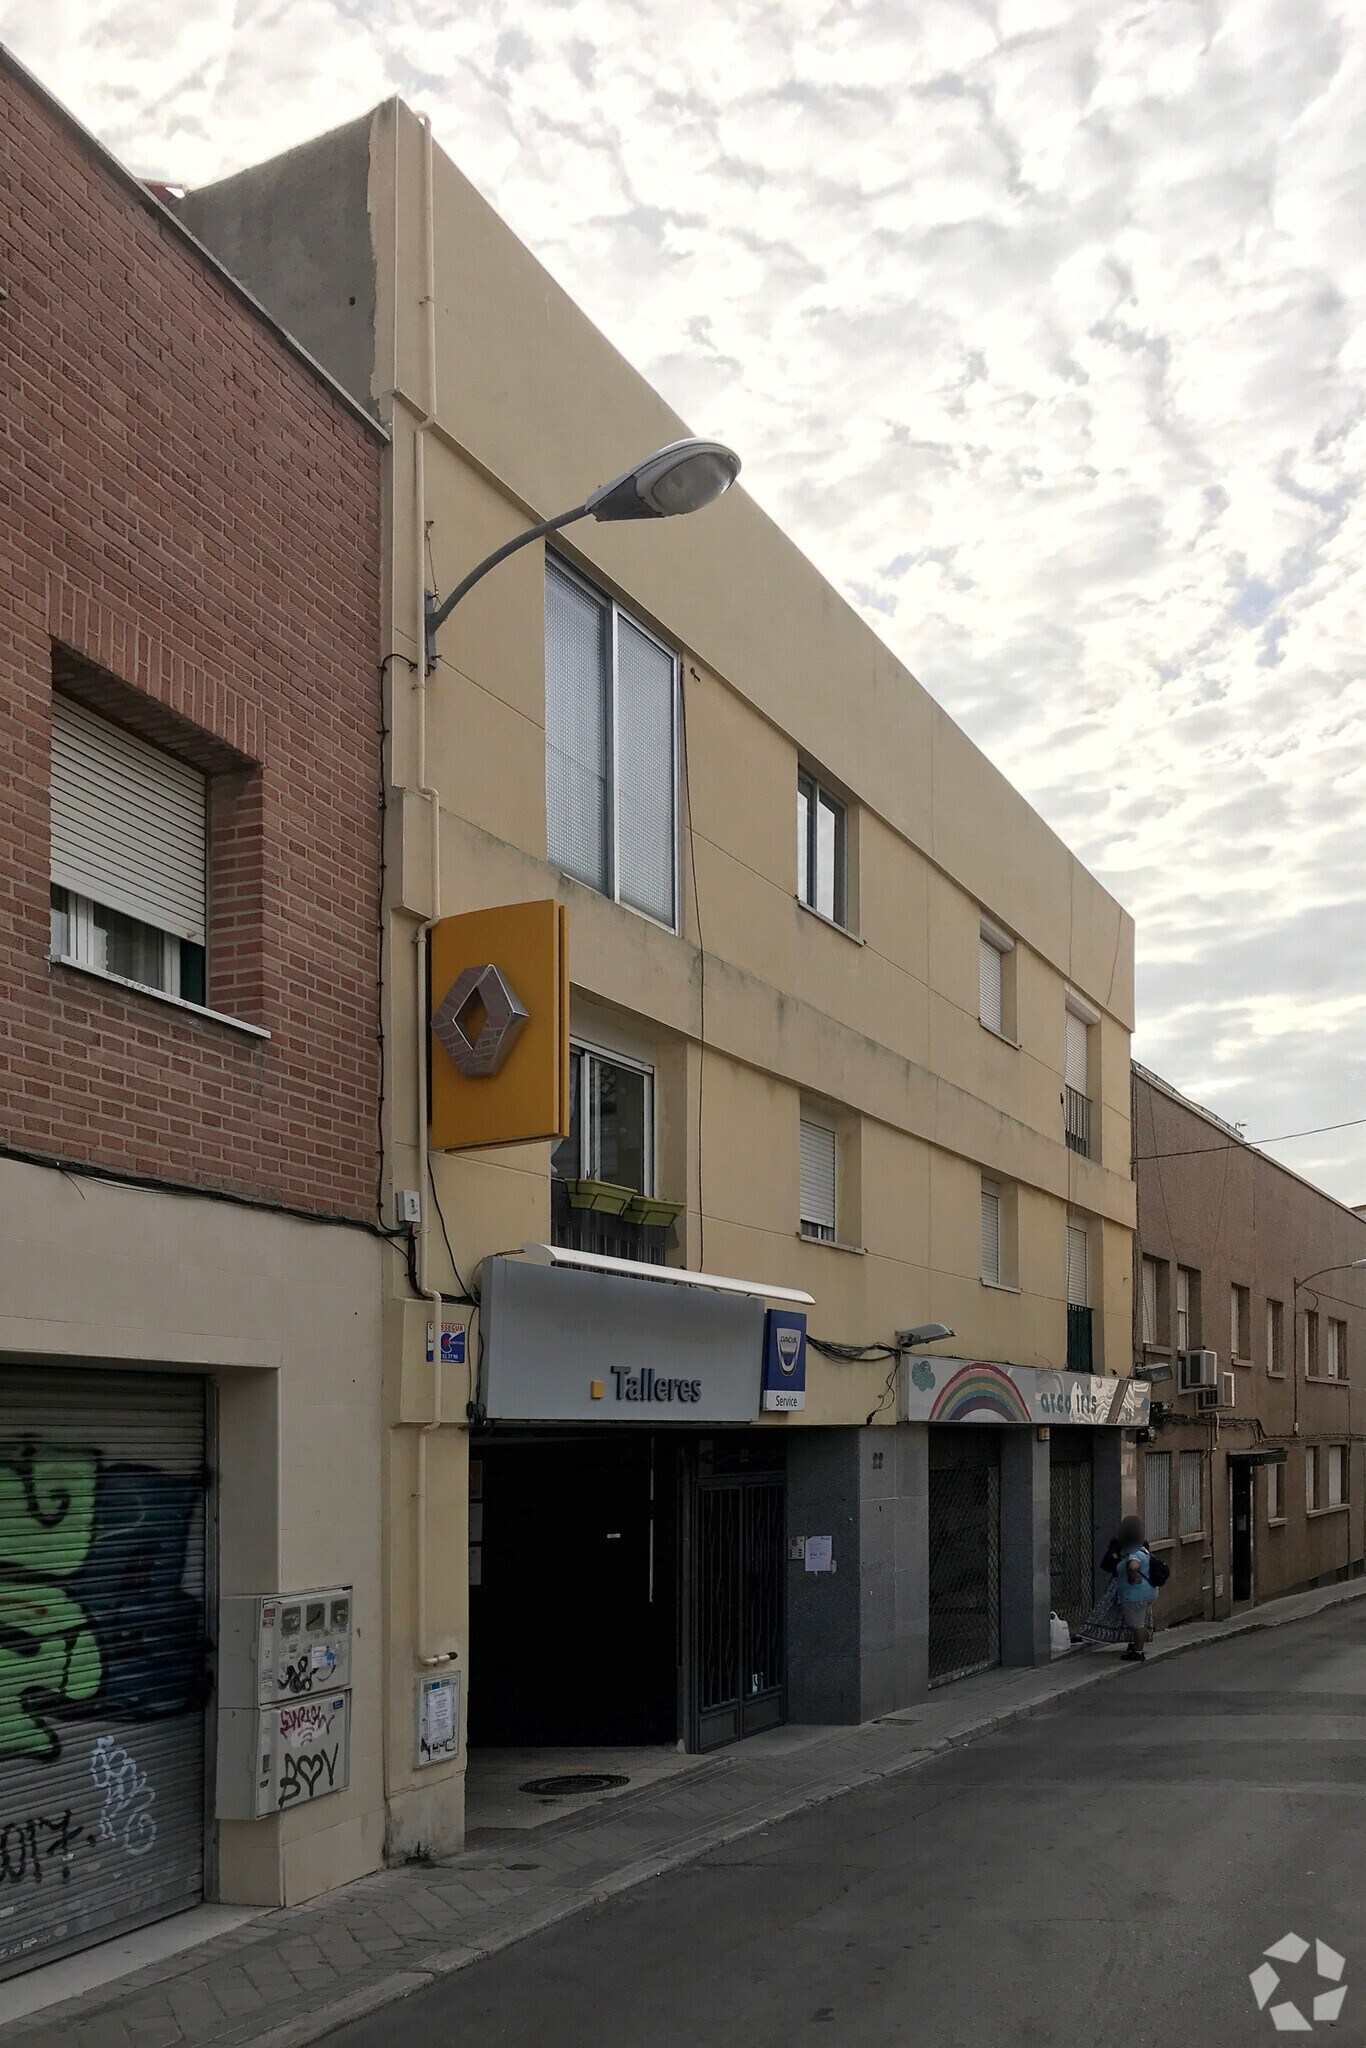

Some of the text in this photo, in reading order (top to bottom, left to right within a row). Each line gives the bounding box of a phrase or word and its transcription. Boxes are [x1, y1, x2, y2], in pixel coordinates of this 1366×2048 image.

[429, 1323, 464, 1332] CSSEGUR
[780, 1335, 798, 1344] DACIA
[610, 1365, 702, 1403] Talleres
[775, 1394, 798, 1408] Service
[1041, 1392, 1072, 1414] arco
[1076, 1384, 1097, 1415] iris
